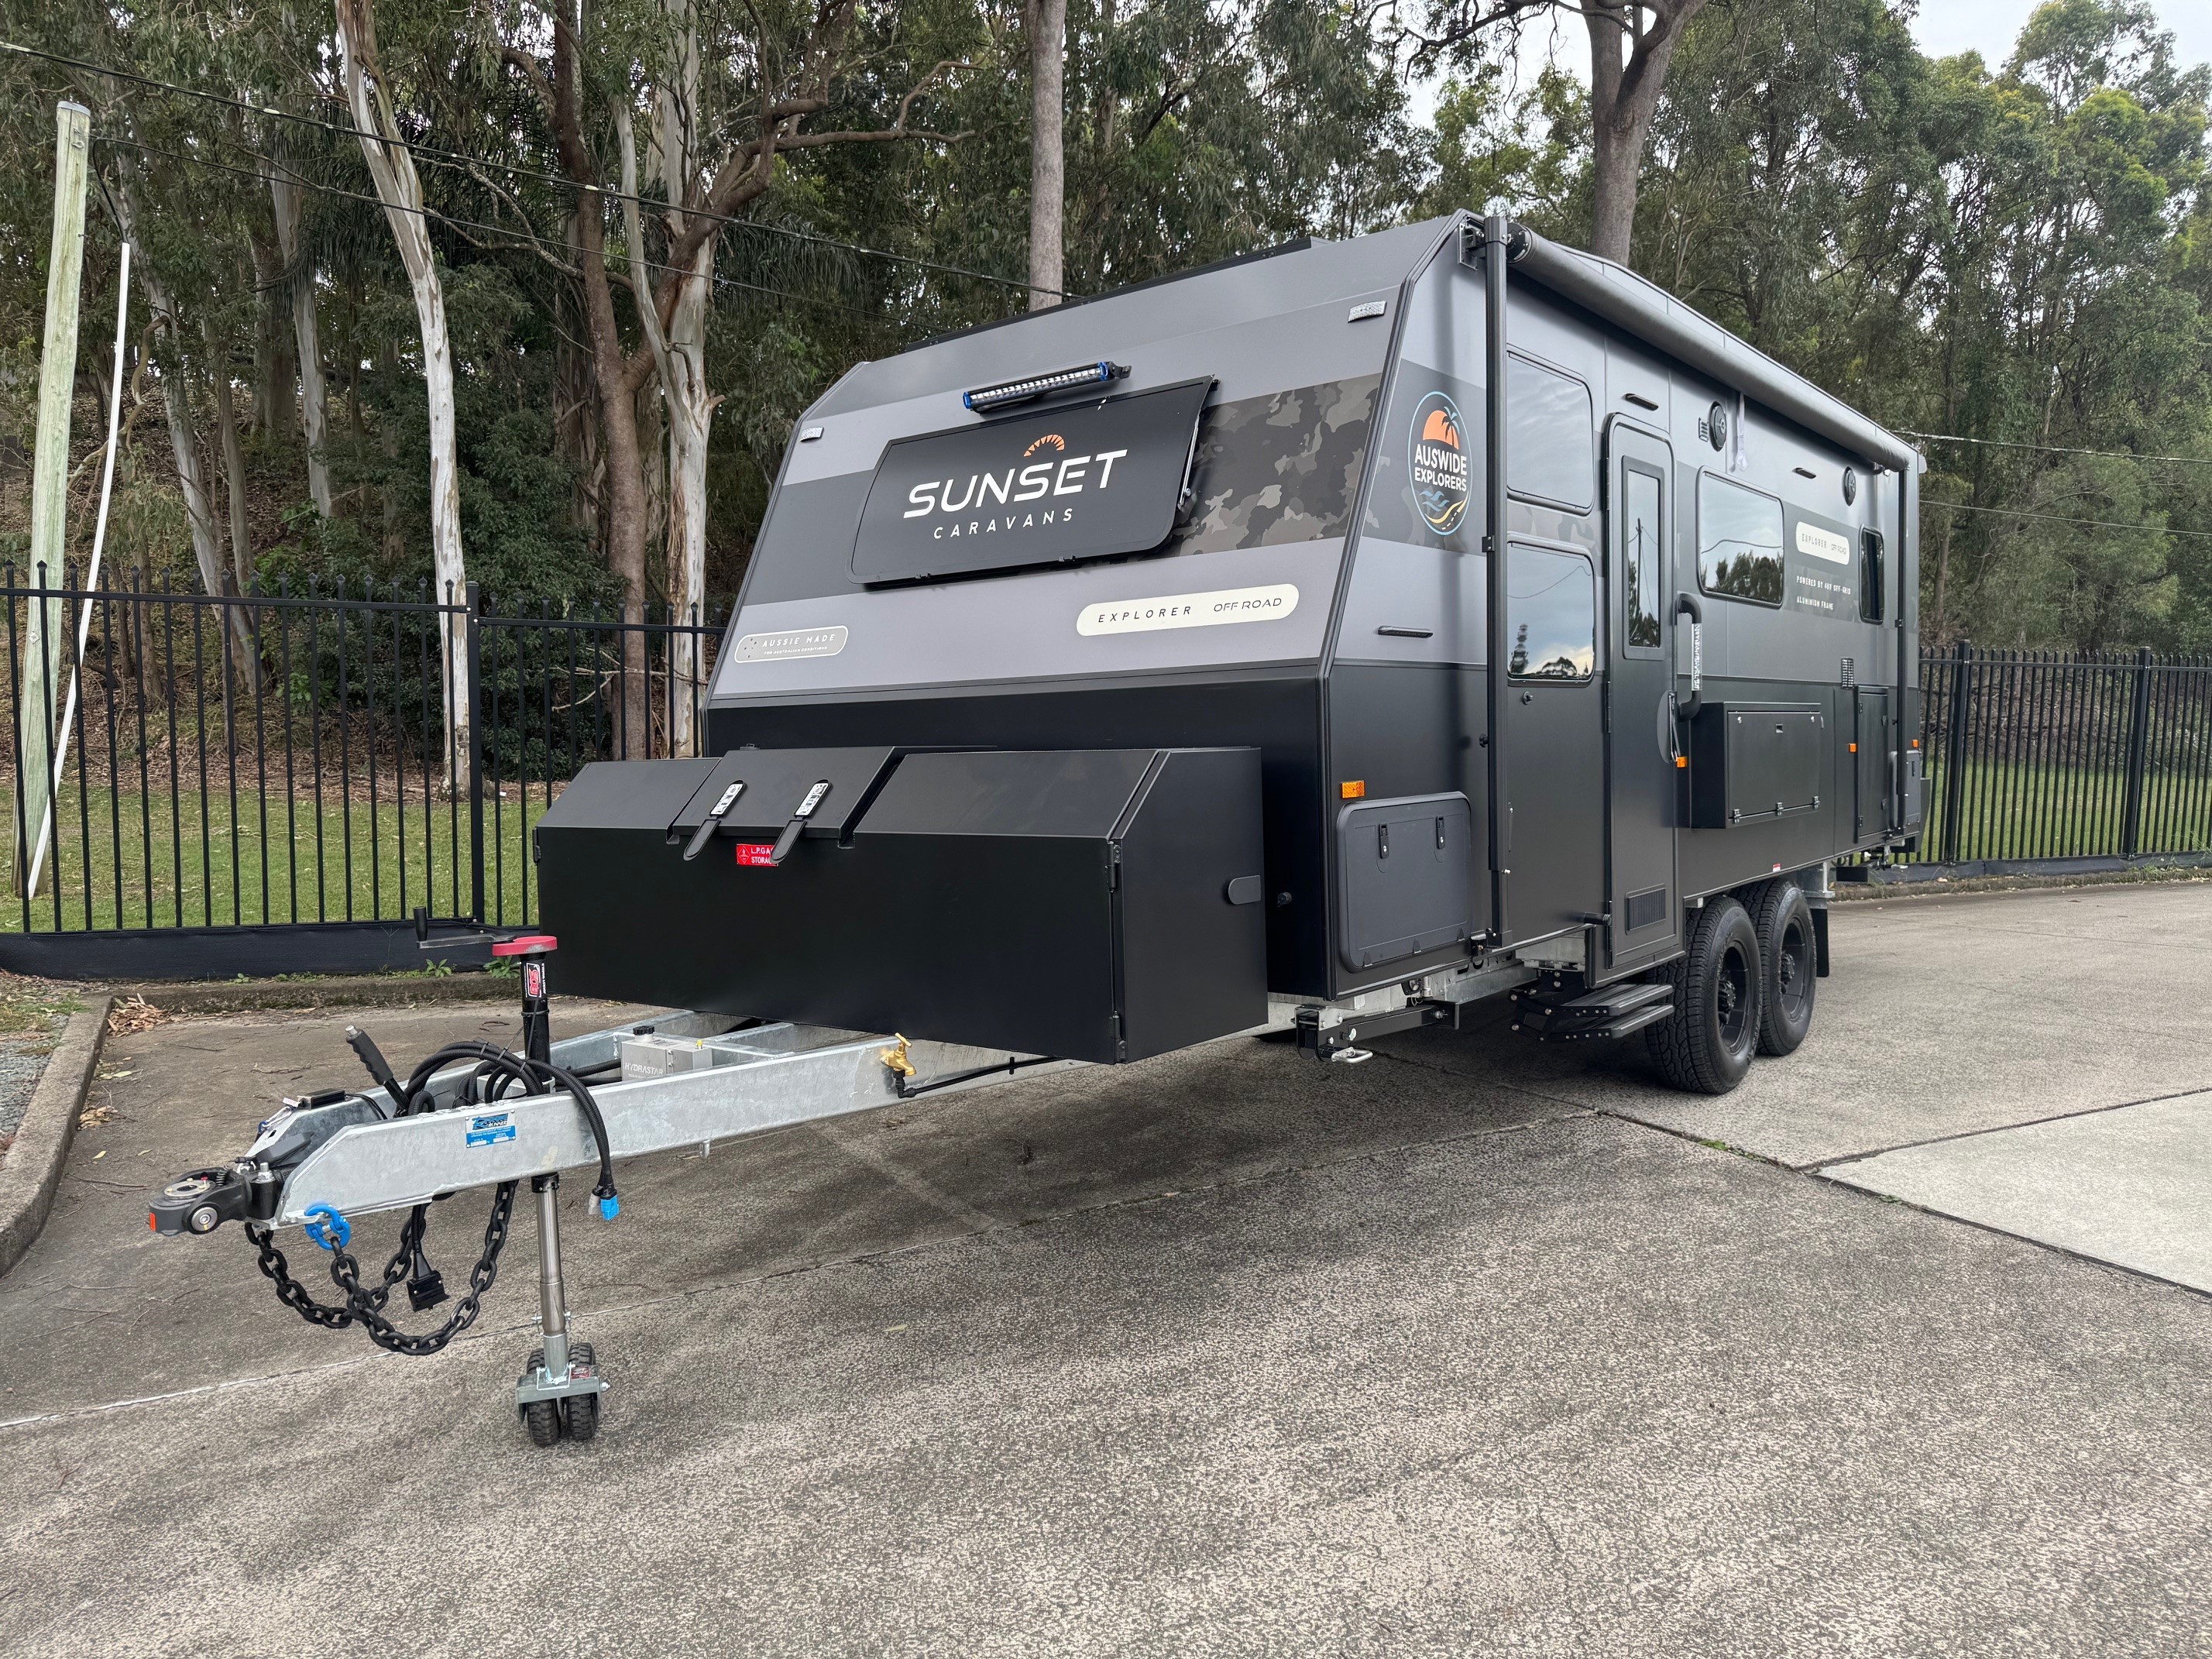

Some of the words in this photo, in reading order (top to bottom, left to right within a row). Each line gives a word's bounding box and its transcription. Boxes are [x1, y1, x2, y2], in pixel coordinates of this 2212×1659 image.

[1414, 444, 1468, 476] AUSWIDE
[903, 449, 1128, 519] SUNSET
[1414, 466, 1467, 492] EXPLORERS
[933, 508, 1073, 539] CARAVANS
[1796, 575, 1816, 587] POWERED
[1098, 606, 1191, 623] EXPLORER
[1213, 602, 1238, 612] OFF
[1242, 598, 1282, 610] ROAD
[1796, 596, 1820, 607] ALUMINIUM
[1821, 600, 1834, 610] FRAME
[762, 637, 800, 647] AUSSIE
[805, 634, 835, 644] MADE
[624, 1062, 664, 1076] HYDRASTAR
